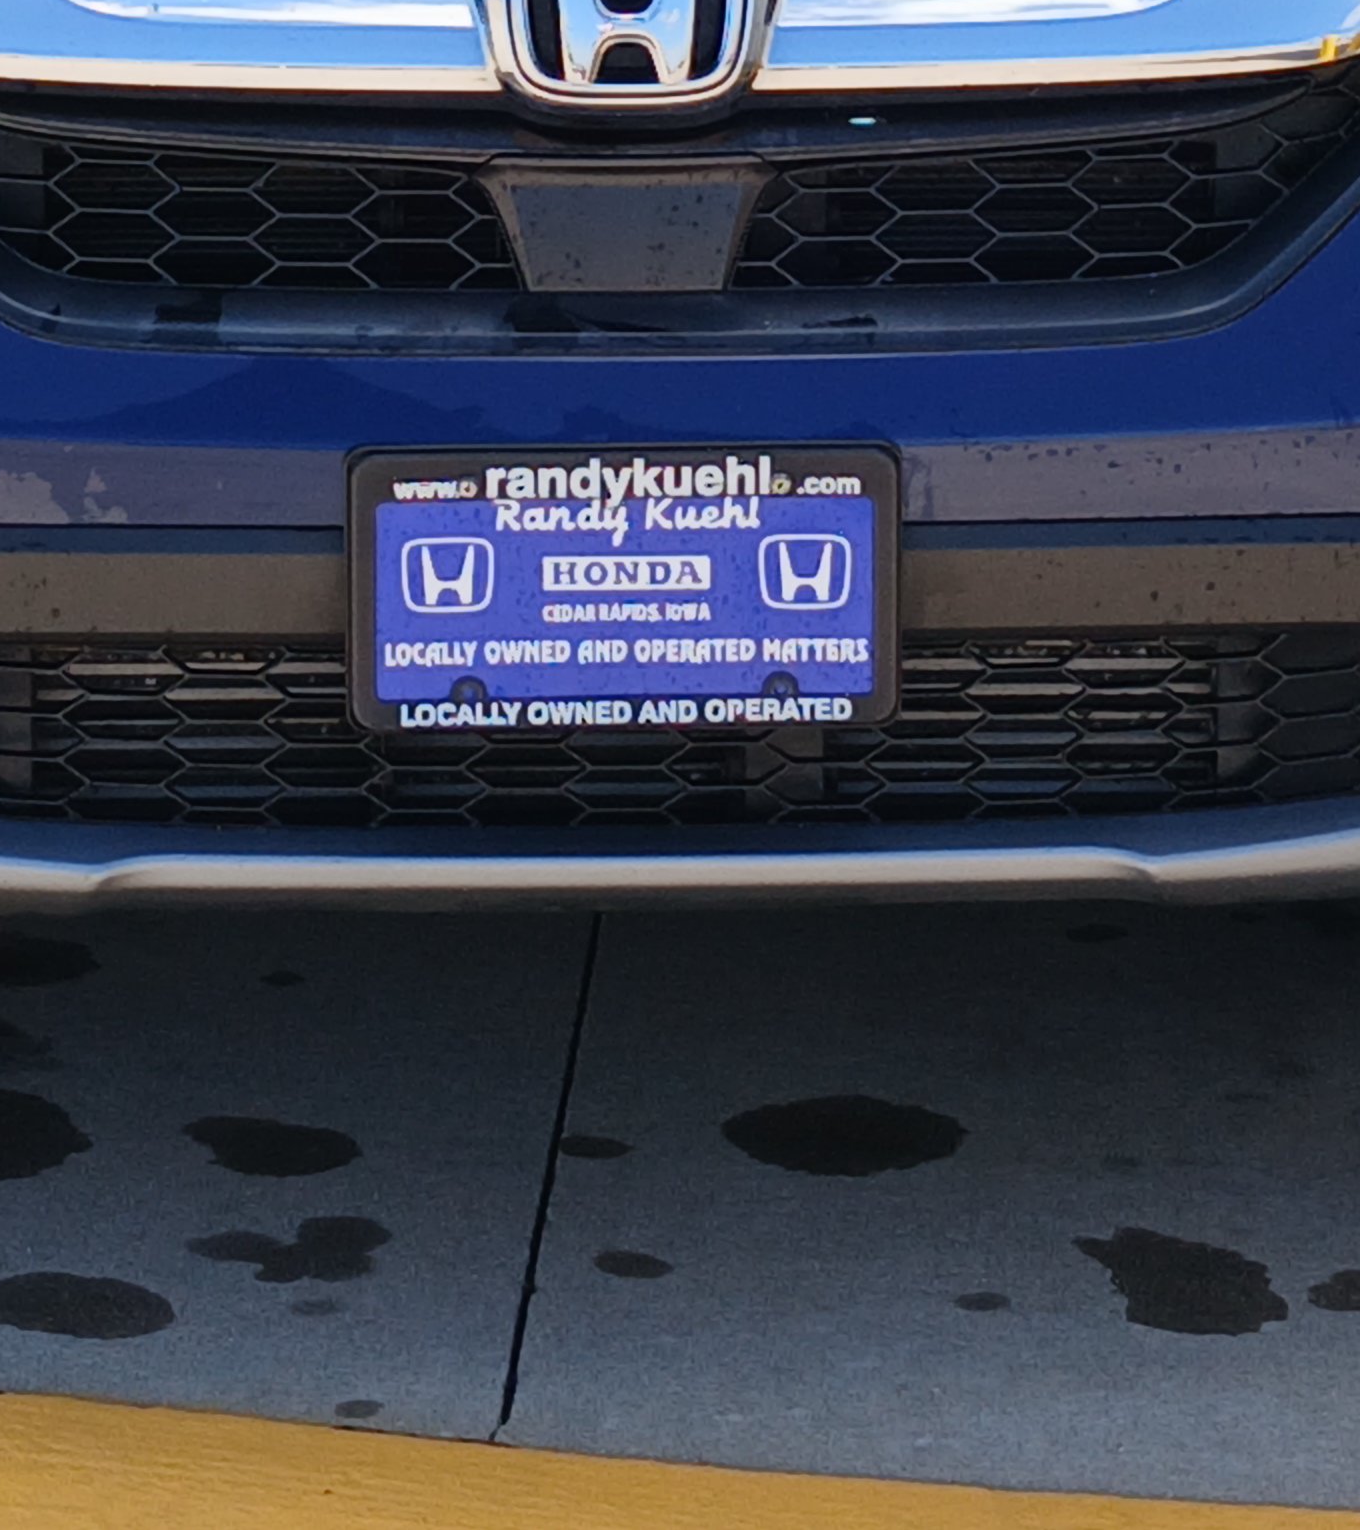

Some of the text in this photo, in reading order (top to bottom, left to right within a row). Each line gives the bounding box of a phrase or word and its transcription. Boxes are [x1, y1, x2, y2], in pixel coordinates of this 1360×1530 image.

[486, 455, 771, 508] randykuehl
[796, 476, 862, 495] .com
[494, 496, 761, 547] Randy Kuehl
[551, 561, 703, 586] HONDA
[666, 602, 711, 621] IOWA
[385, 637, 869, 668] LOCALLY OWNED AND OPERATED MATTERS
[400, 697, 853, 728] LOCALLY OWNED AND OPERATED
